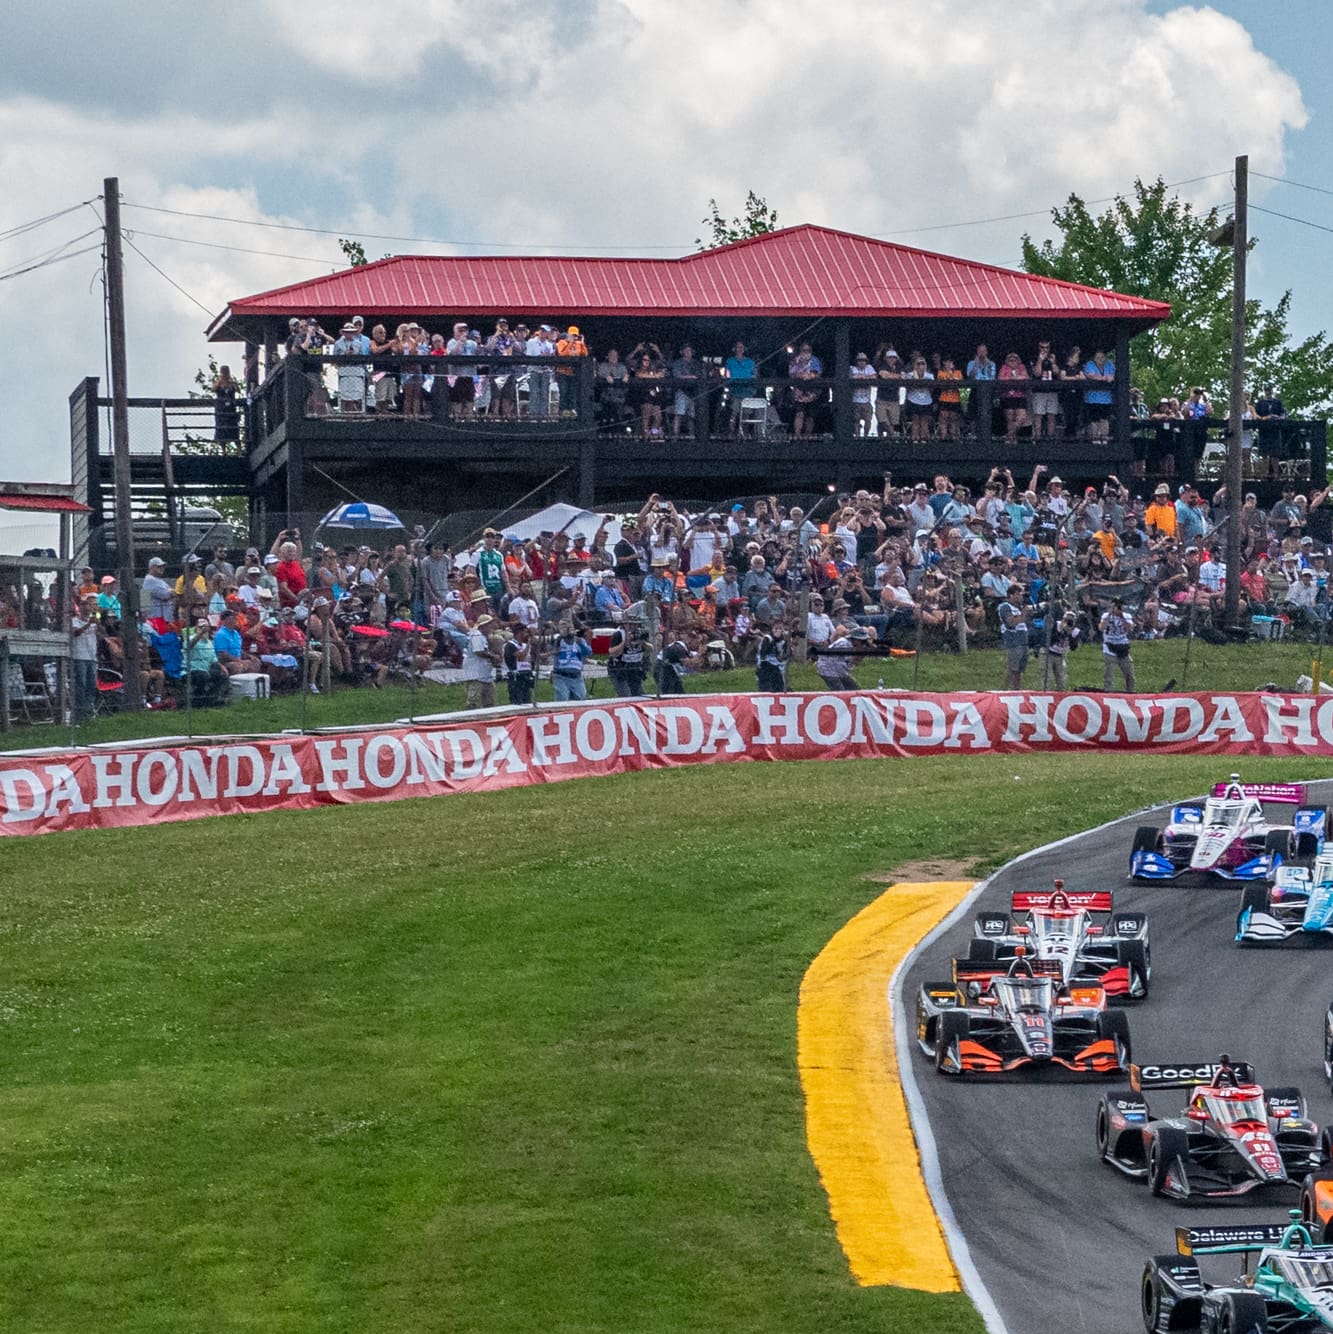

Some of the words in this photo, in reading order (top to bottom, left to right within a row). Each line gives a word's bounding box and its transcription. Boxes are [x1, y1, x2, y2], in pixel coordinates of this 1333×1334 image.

[91, 744, 311, 808] HONDA
[314, 726, 527, 791] HONDA
[526, 705, 747, 766] HONDA
[750, 695, 991, 748] HONDA
[1000, 695, 1254, 742] HONDA
